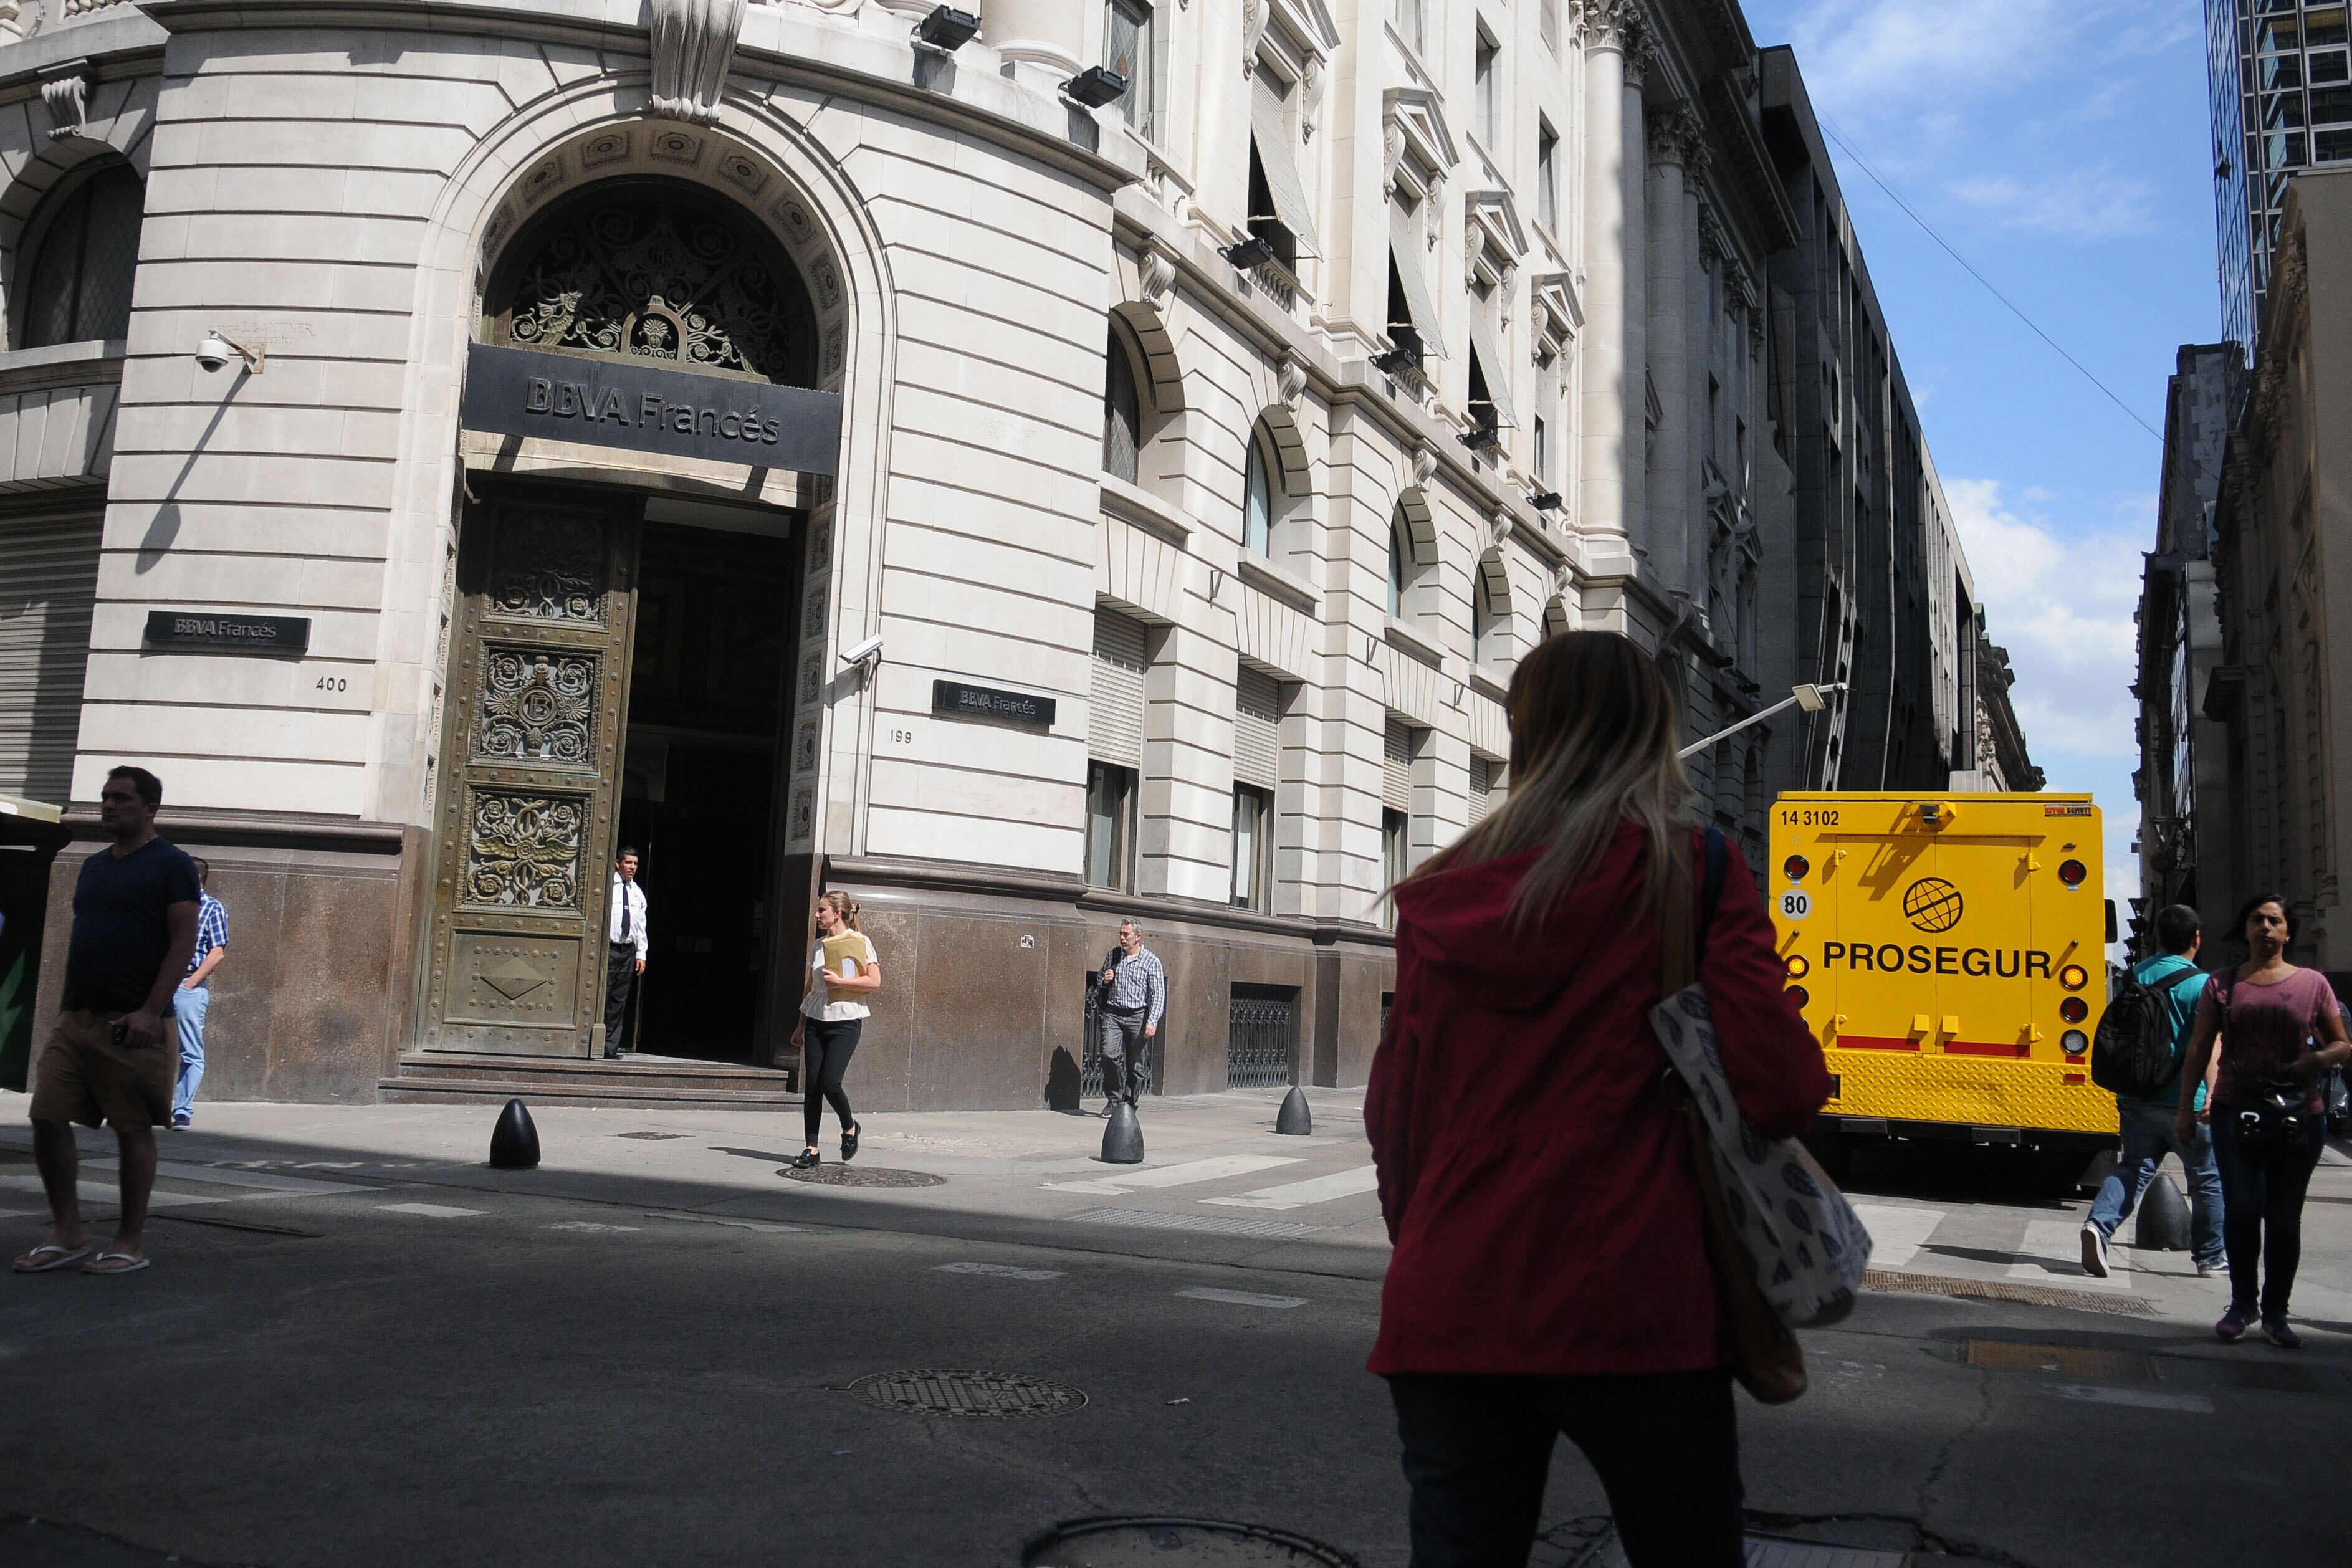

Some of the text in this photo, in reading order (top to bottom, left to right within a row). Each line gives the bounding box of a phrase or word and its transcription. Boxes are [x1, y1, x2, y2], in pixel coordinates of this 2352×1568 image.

[526, 376, 780, 444] BBVA Francés
[174, 618, 277, 638] BBVA Francés
[316, 676, 347, 692] 400
[960, 691, 1036, 715] BBVA Francés
[891, 729, 912, 744] 199
[1781, 810, 1839, 826] 14 3102
[1784, 896, 1807, 914] 80
[1824, 942, 2052, 979] PROSEGUR
